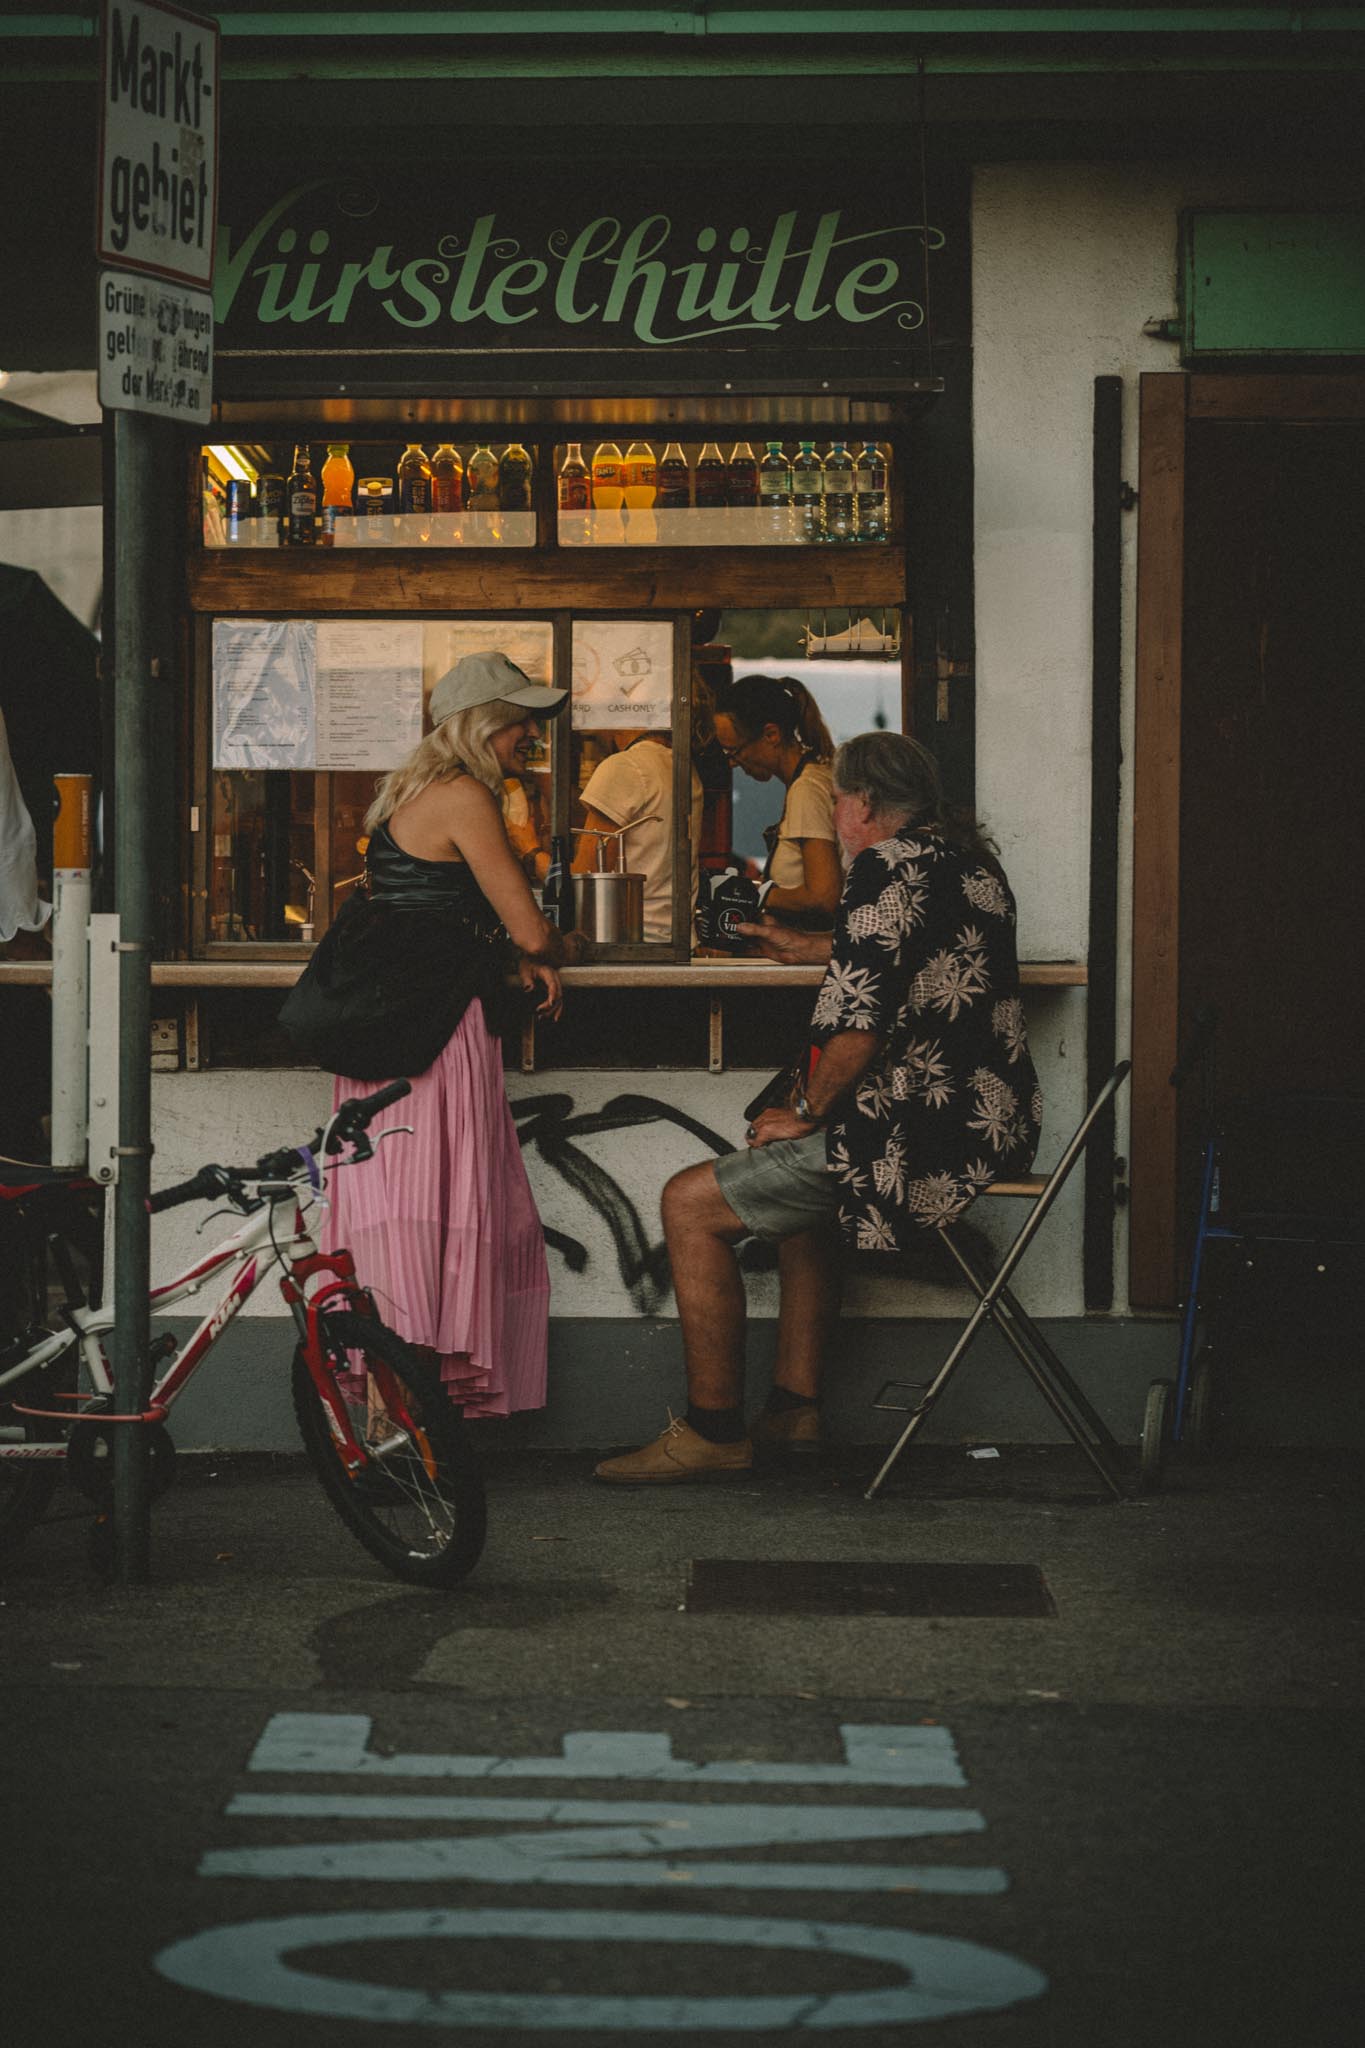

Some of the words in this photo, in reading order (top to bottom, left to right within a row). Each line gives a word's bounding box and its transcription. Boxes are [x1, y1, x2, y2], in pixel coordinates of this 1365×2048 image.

[111, 8, 212, 130] Markt-
[110, 142, 208, 251] gebiet
[607, 704, 631, 713] CASH
[632, 704, 656, 713] ONLY
